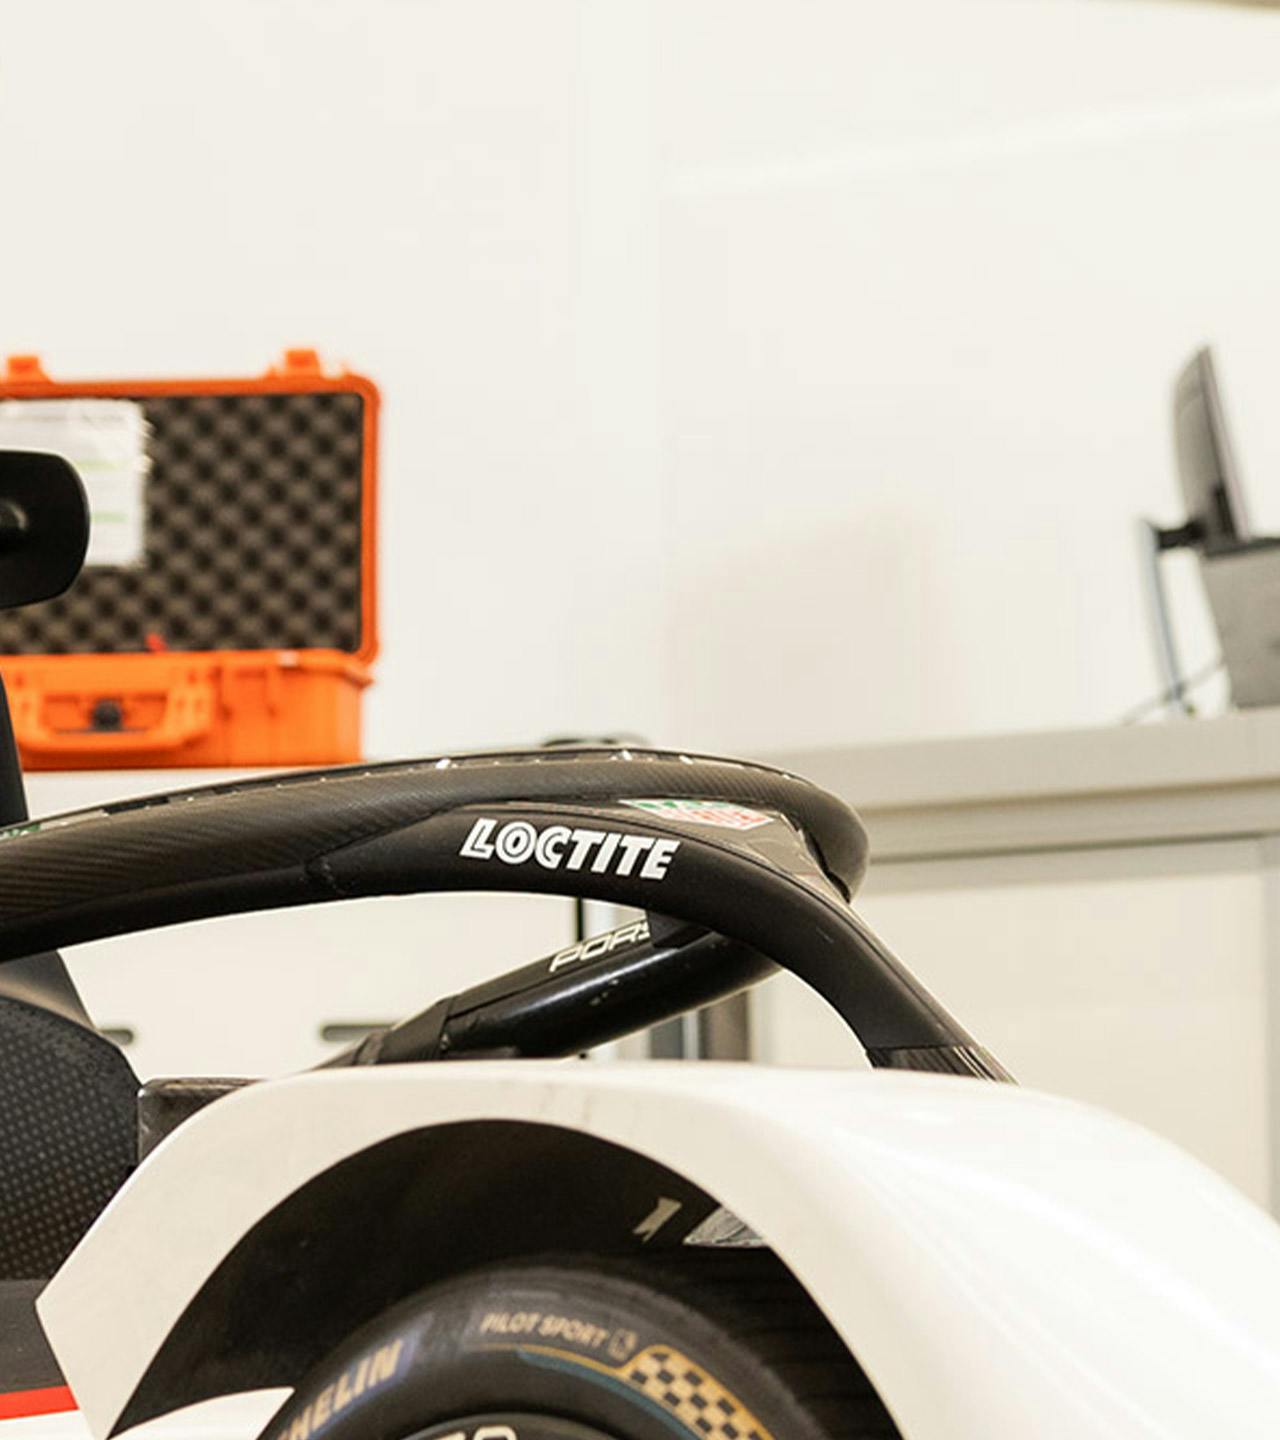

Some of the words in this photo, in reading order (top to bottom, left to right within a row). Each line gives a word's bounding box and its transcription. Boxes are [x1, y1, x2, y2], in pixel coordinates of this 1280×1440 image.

[459, 817, 681, 881] LOCTITE
[480, 1311, 541, 1334] PILOT
[538, 1314, 609, 1348] SPORT
